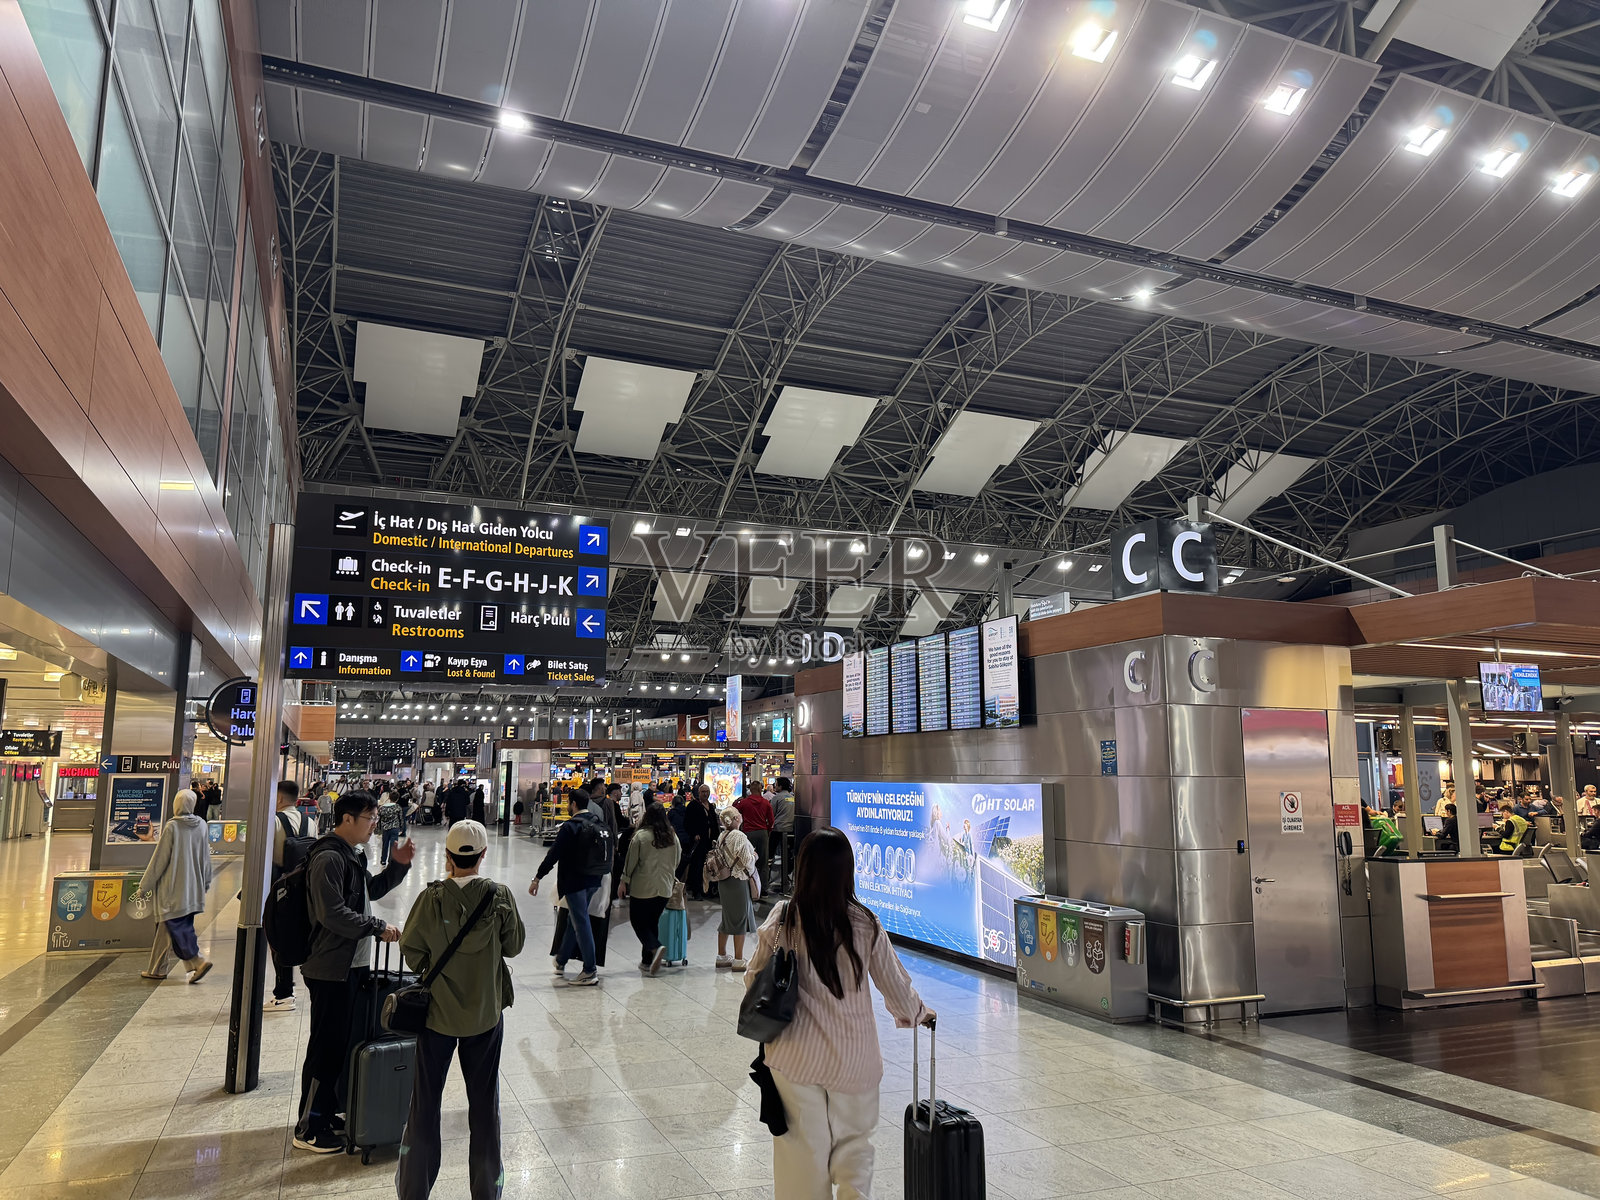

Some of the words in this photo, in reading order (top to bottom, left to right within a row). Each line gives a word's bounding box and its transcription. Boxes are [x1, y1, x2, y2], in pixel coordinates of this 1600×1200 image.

[373, 511, 386, 530] İç
[390, 515, 414, 529] Hat
[417, 517, 424, 530] /
[427, 518, 448, 534] Dış
[452, 520, 476, 534] Hat
[479, 522, 517, 537] Giden
[520, 526, 553, 540] Yolcu
[373, 532, 428, 548] Domestic
[431, 536, 436, 548] /
[439, 537, 511, 554] International
[515, 543, 574, 558] Departures
[1122, 532, 1148, 584] C
[1172, 531, 1204, 582] C
[371, 559, 431, 574] Check-in
[370, 577, 430, 592] Check-in
[438, 567, 574, 596] E-F-G-H-J-K
[393, 605, 462, 620] Tuvaletler
[511, 611, 540, 627] Harç
[543, 613, 570, 626] Pulu
[392, 623, 465, 638] Restrooms
[824, 632, 845, 662] D
[338, 653, 378, 664] Danışma
[447, 656, 469, 667] Kayıp
[470, 657, 488, 668] Eşya
[547, 660, 566, 670] Bilet
[568, 661, 588, 672] Satış
[338, 665, 391, 676] Information
[447, 668, 464, 677] Lost
[465, 669, 471, 677] &
[473, 669, 496, 678] Found
[547, 672, 572, 681] Ticket
[574, 673, 595, 681] Sales
[1124, 650, 1147, 692] C
[1187, 650, 1217, 692] C
[230, 725, 255, 736] Pulu
[483, 732, 491, 743] F
[507, 726, 515, 738] E
[427, 749, 435, 757] G
[139, 760, 160, 770] Harç
[162, 761, 180, 769] Pulu
[846, 789, 883, 804] TÜRKİYE'NİN
[884, 791, 925, 807] GELECEĞİNİ
[987, 798, 1002, 811] HT
[1003, 798, 1035, 812] SOLAR
[856, 807, 914, 822] AYDINLATIYORUZ!
